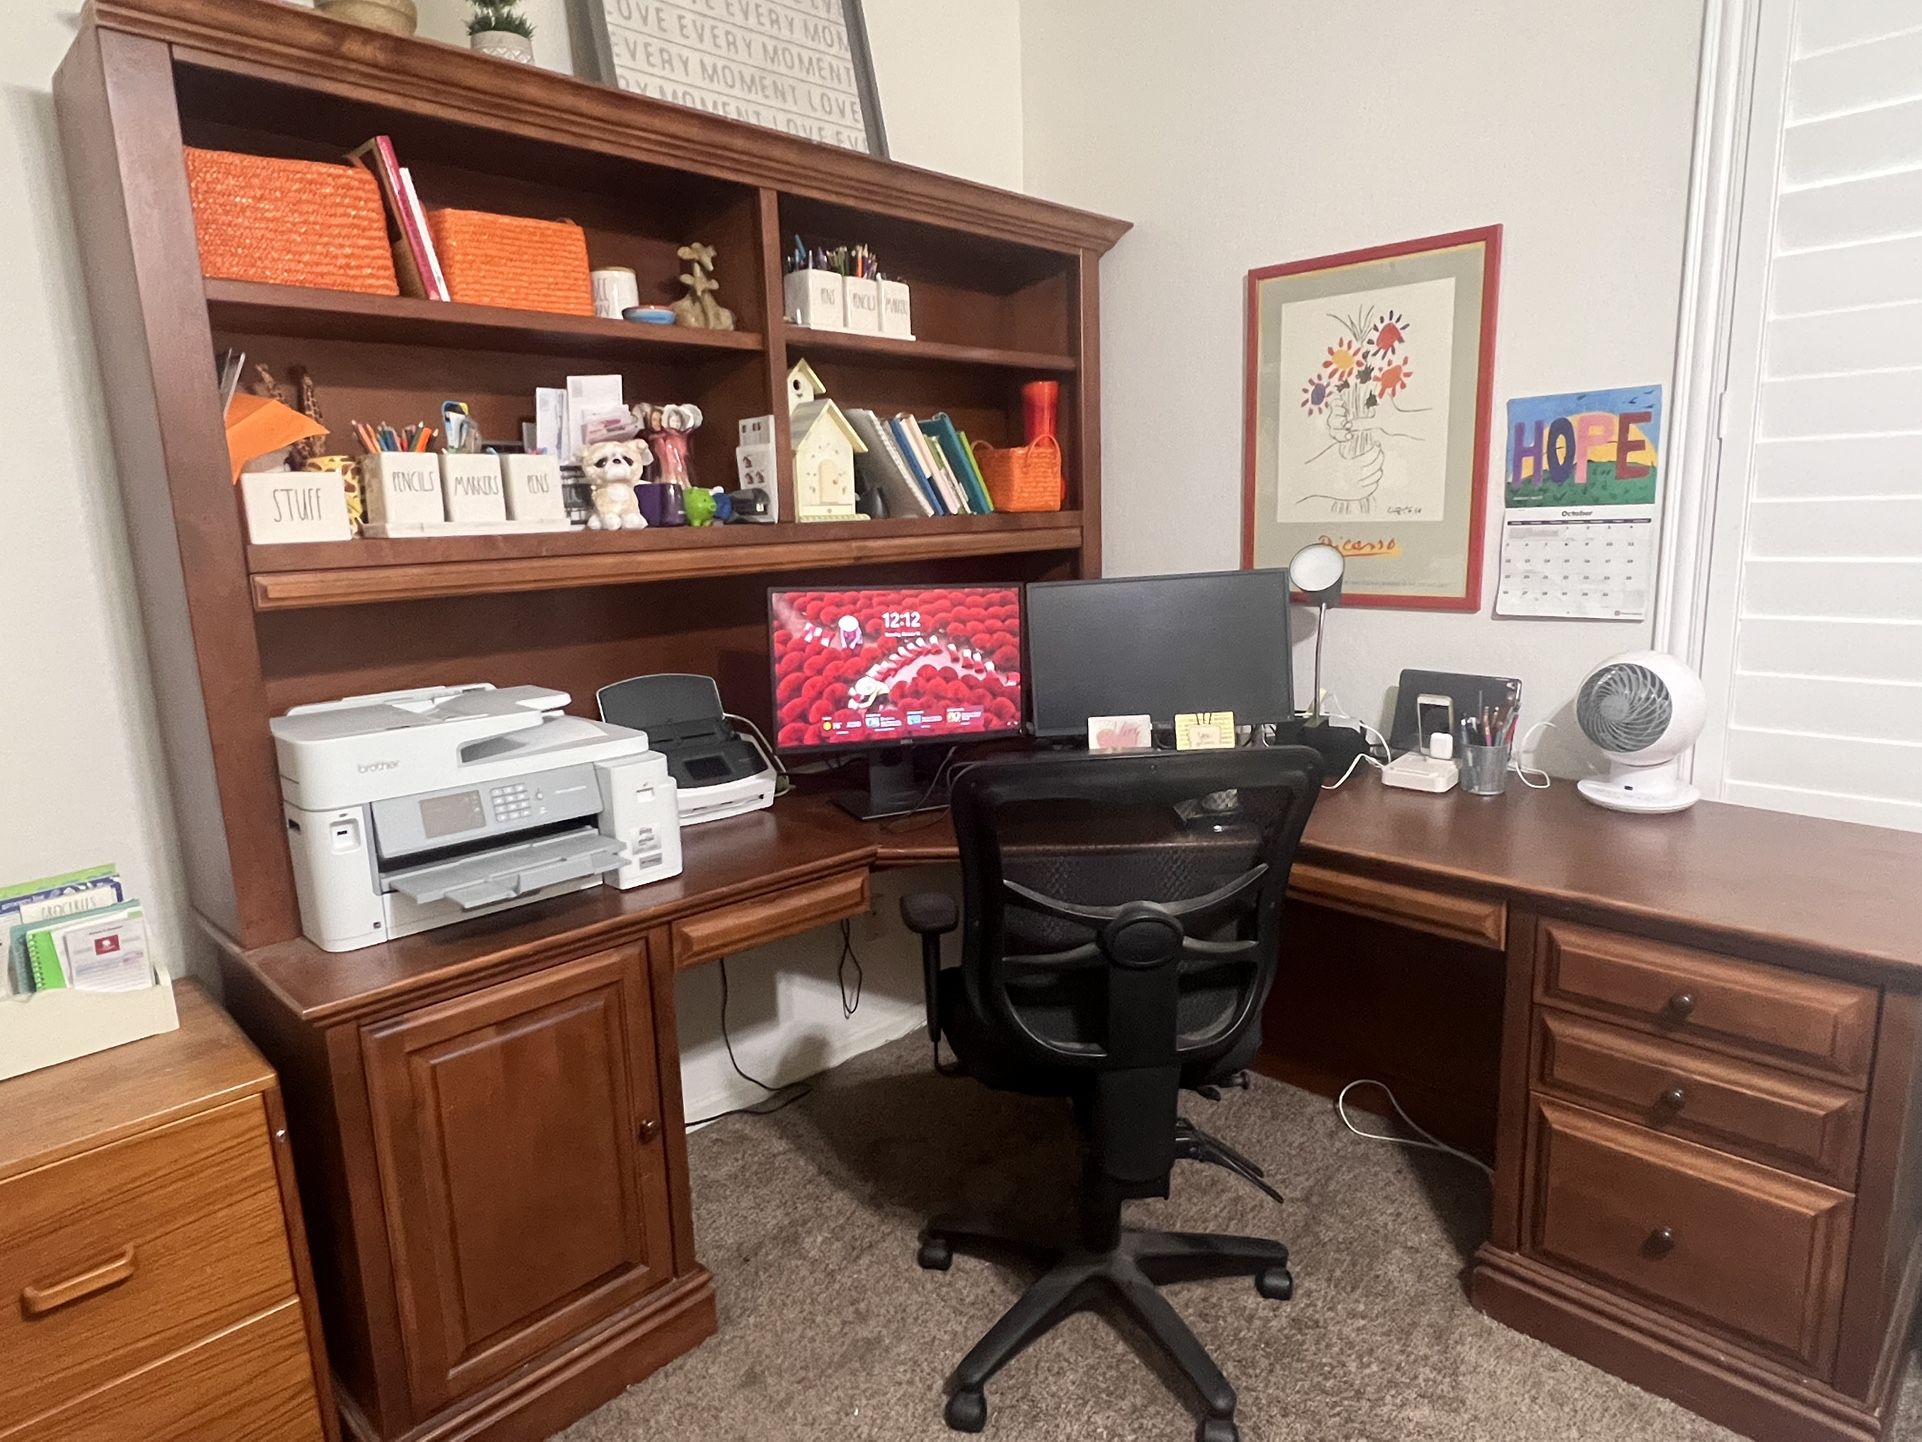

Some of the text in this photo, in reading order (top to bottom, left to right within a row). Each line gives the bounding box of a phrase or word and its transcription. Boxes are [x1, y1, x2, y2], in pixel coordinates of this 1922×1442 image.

[678, 14, 752, 58] EVERY
[762, 41, 854, 87] MOMENT
[700, 58, 798, 106] MOMENT
[808, 90, 861, 123] LOVE
[1512, 411, 1652, 491] HOPE
[392, 471, 434, 492] PENCILS
[454, 474, 499, 496] MARKERS
[527, 474, 549, 494] PENS
[273, 488, 322, 523] STUFF
[881, 611, 921, 628] 12:12
[357, 760, 400, 774] brother
